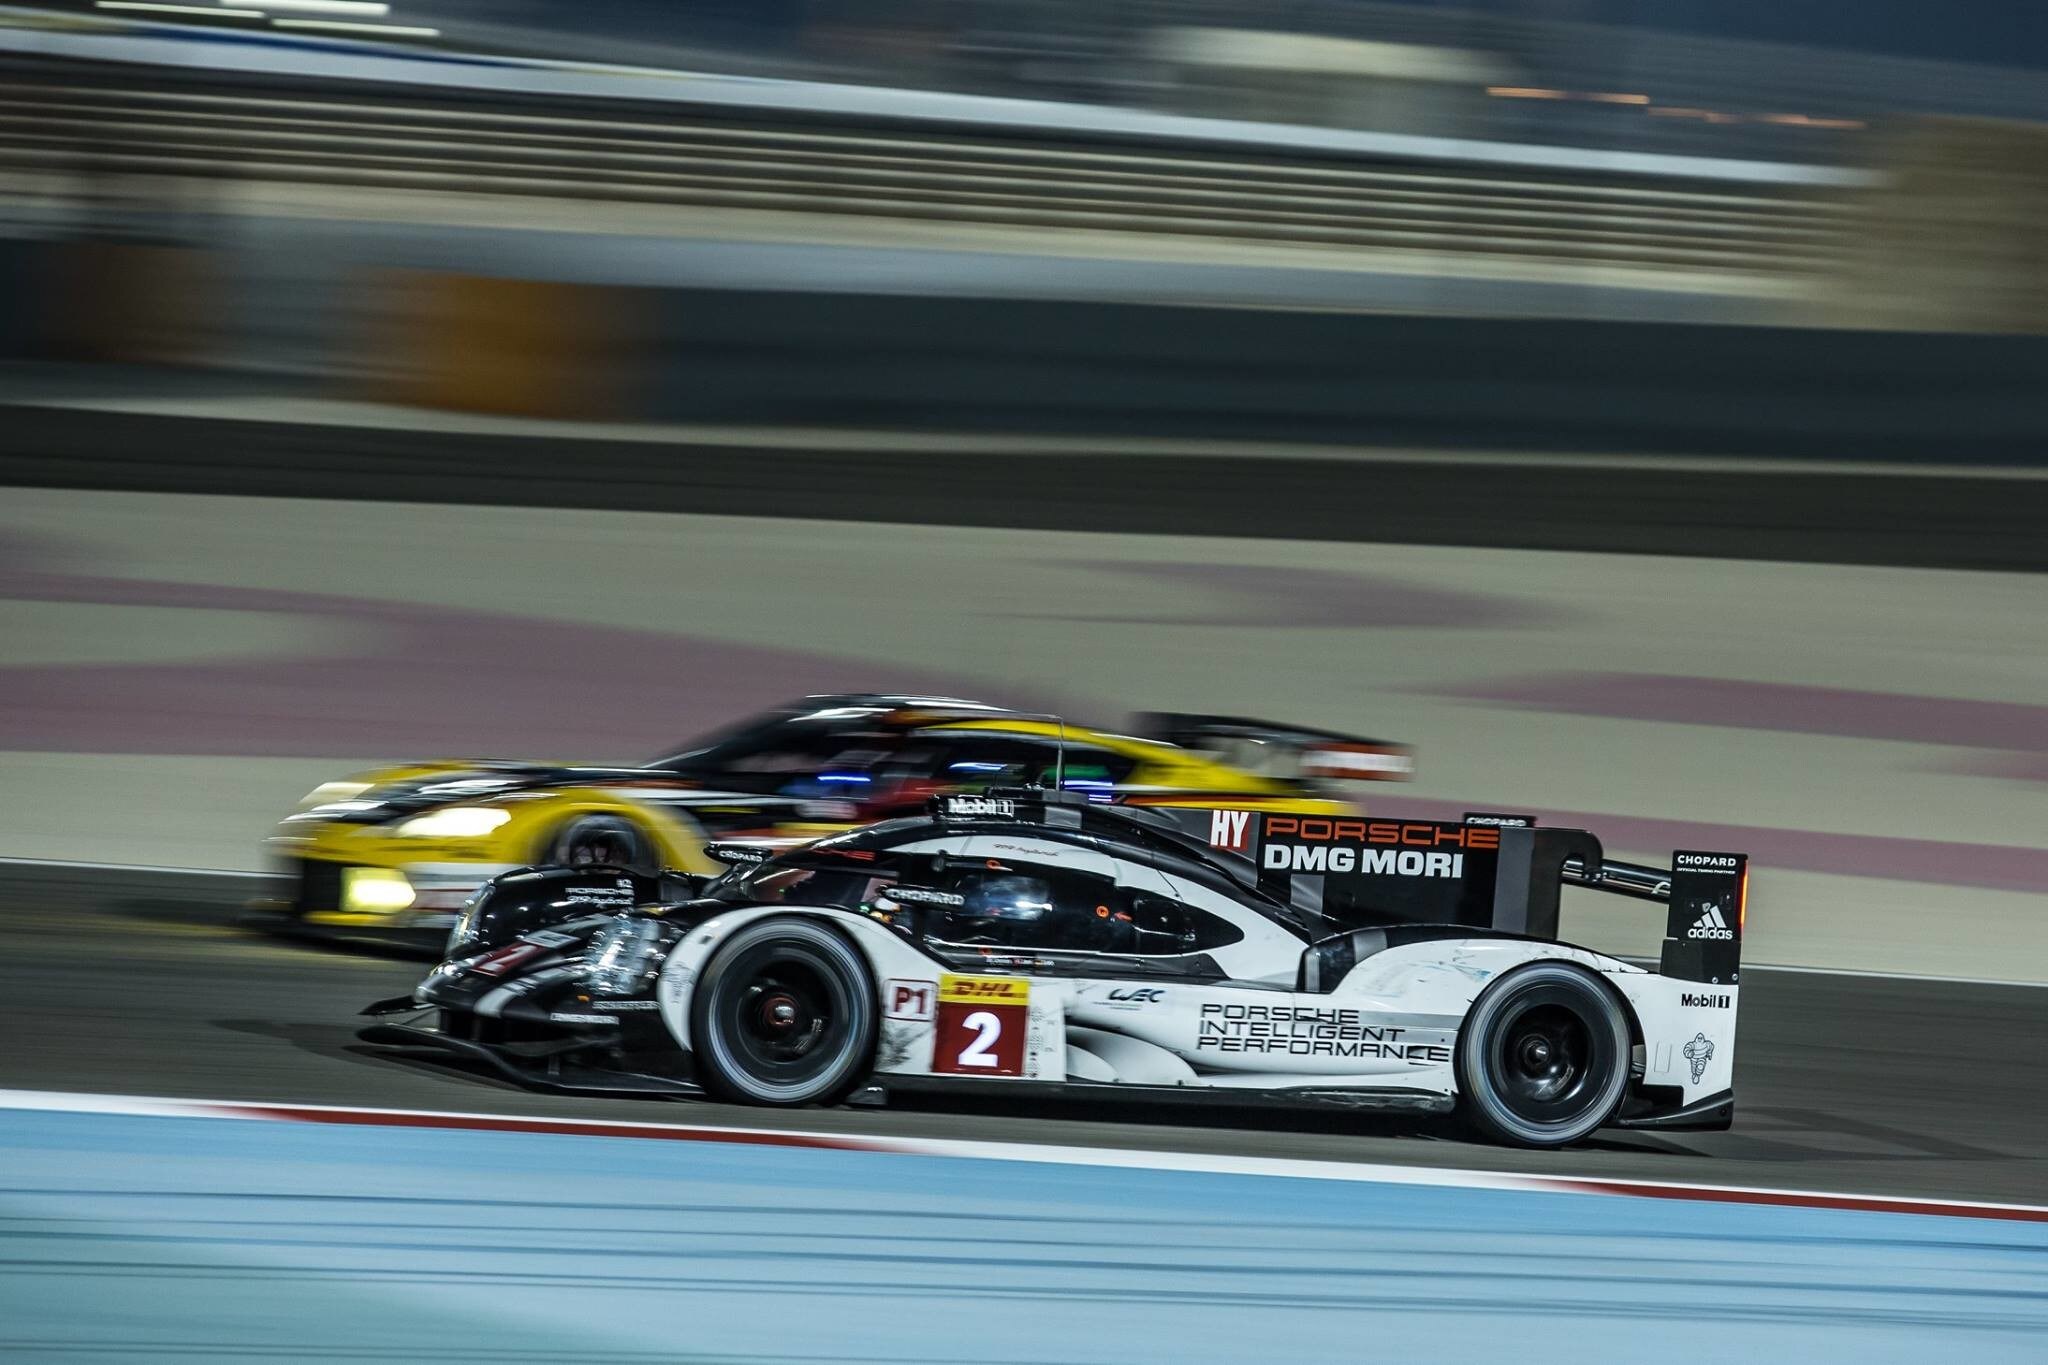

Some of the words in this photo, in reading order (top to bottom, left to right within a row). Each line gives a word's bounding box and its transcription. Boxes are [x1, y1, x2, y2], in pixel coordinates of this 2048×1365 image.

[948, 798, 997, 815] Mobil
[1209, 809, 1249, 848] HY
[1266, 817, 1500, 849] PORSCHE
[718, 850, 763, 862] CHOPARD
[1263, 844, 1355, 872] DMG
[1361, 850, 1464, 878] MORI
[1677, 854, 1737, 867] CHOPARD
[1687, 926, 1733, 940] adidas
[893, 986, 928, 1015] P1
[952, 981, 1014, 998] DHL
[1681, 993, 1717, 1008] Mobil
[1201, 1003, 1360, 1025] PORSCHE
[957, 1011, 1001, 1067] 2
[1199, 1020, 1406, 1043] INTELLIGENT
[1197, 1036, 1451, 1063] PERFORMANCE
